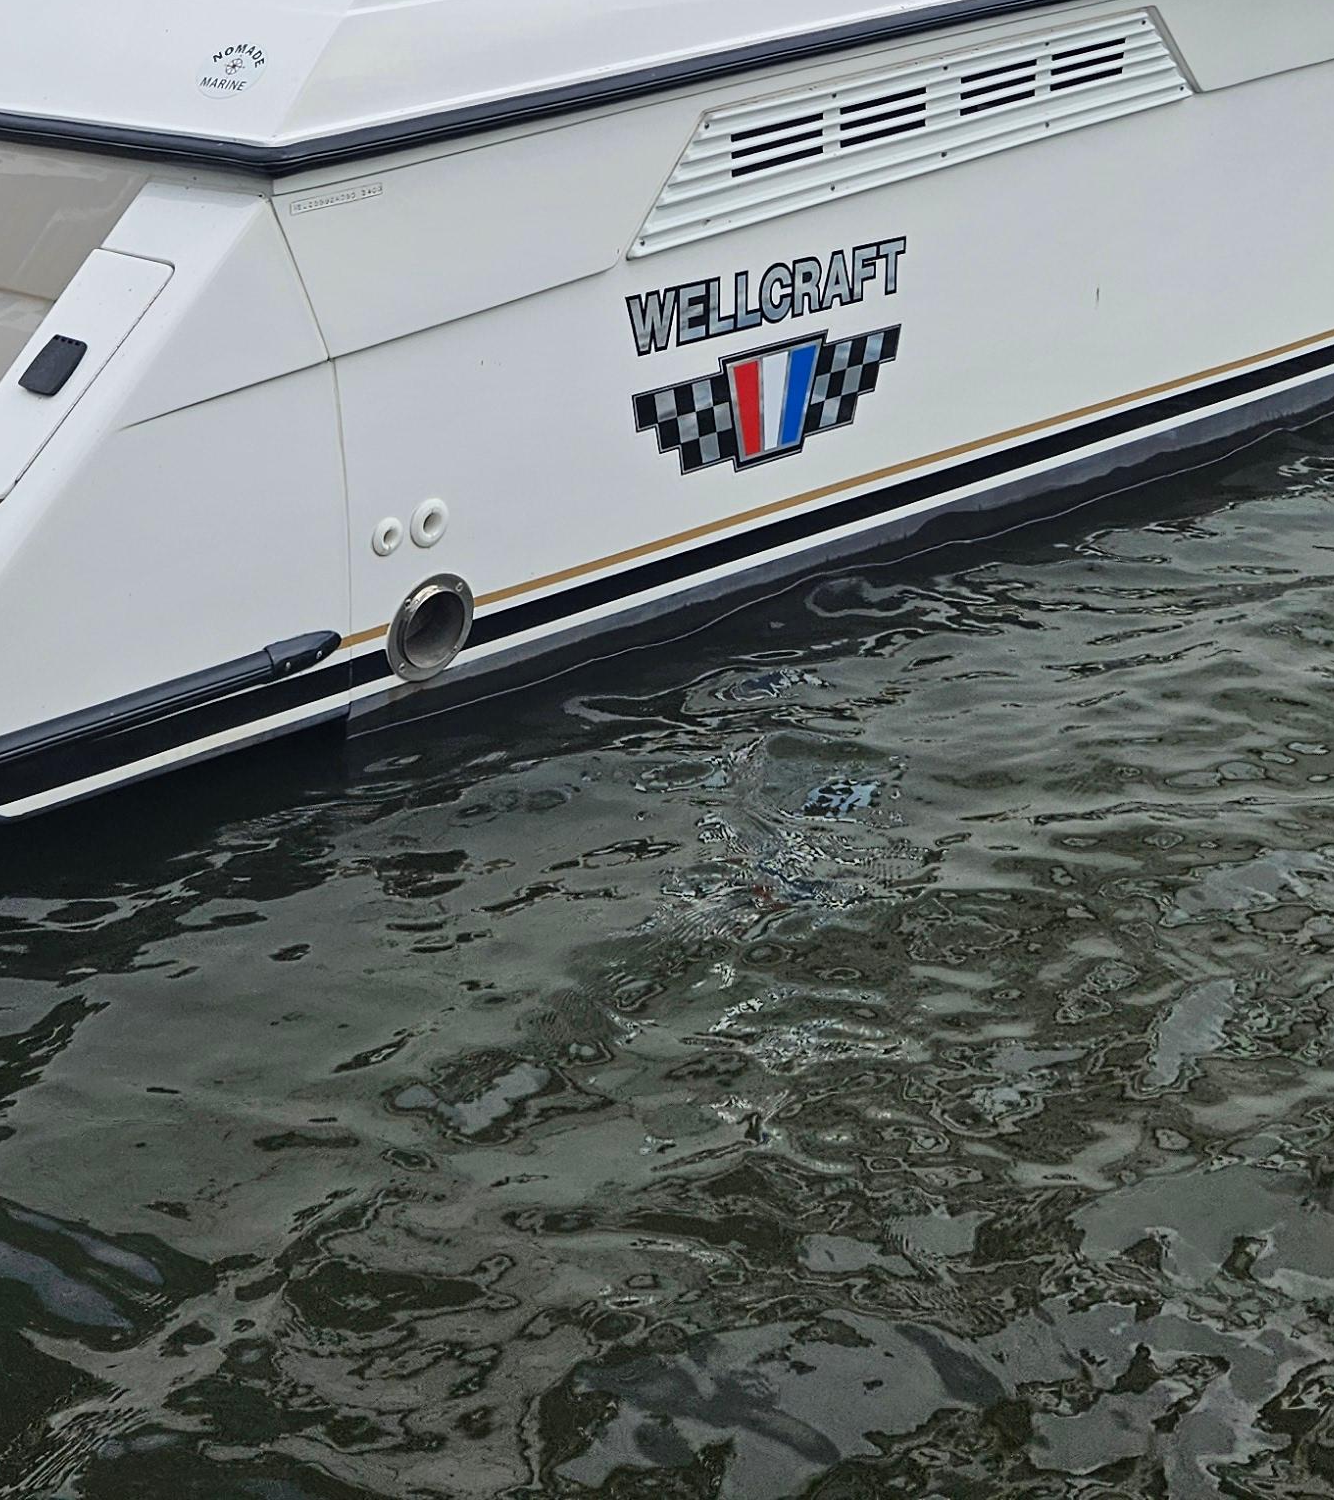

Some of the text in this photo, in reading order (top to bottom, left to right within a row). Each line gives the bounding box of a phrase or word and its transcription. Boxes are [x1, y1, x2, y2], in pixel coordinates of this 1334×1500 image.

[212, 43, 265, 68] NOMADE
[199, 76, 247, 91] MARINE
[625, 235, 907, 357] WELLCRAFT
